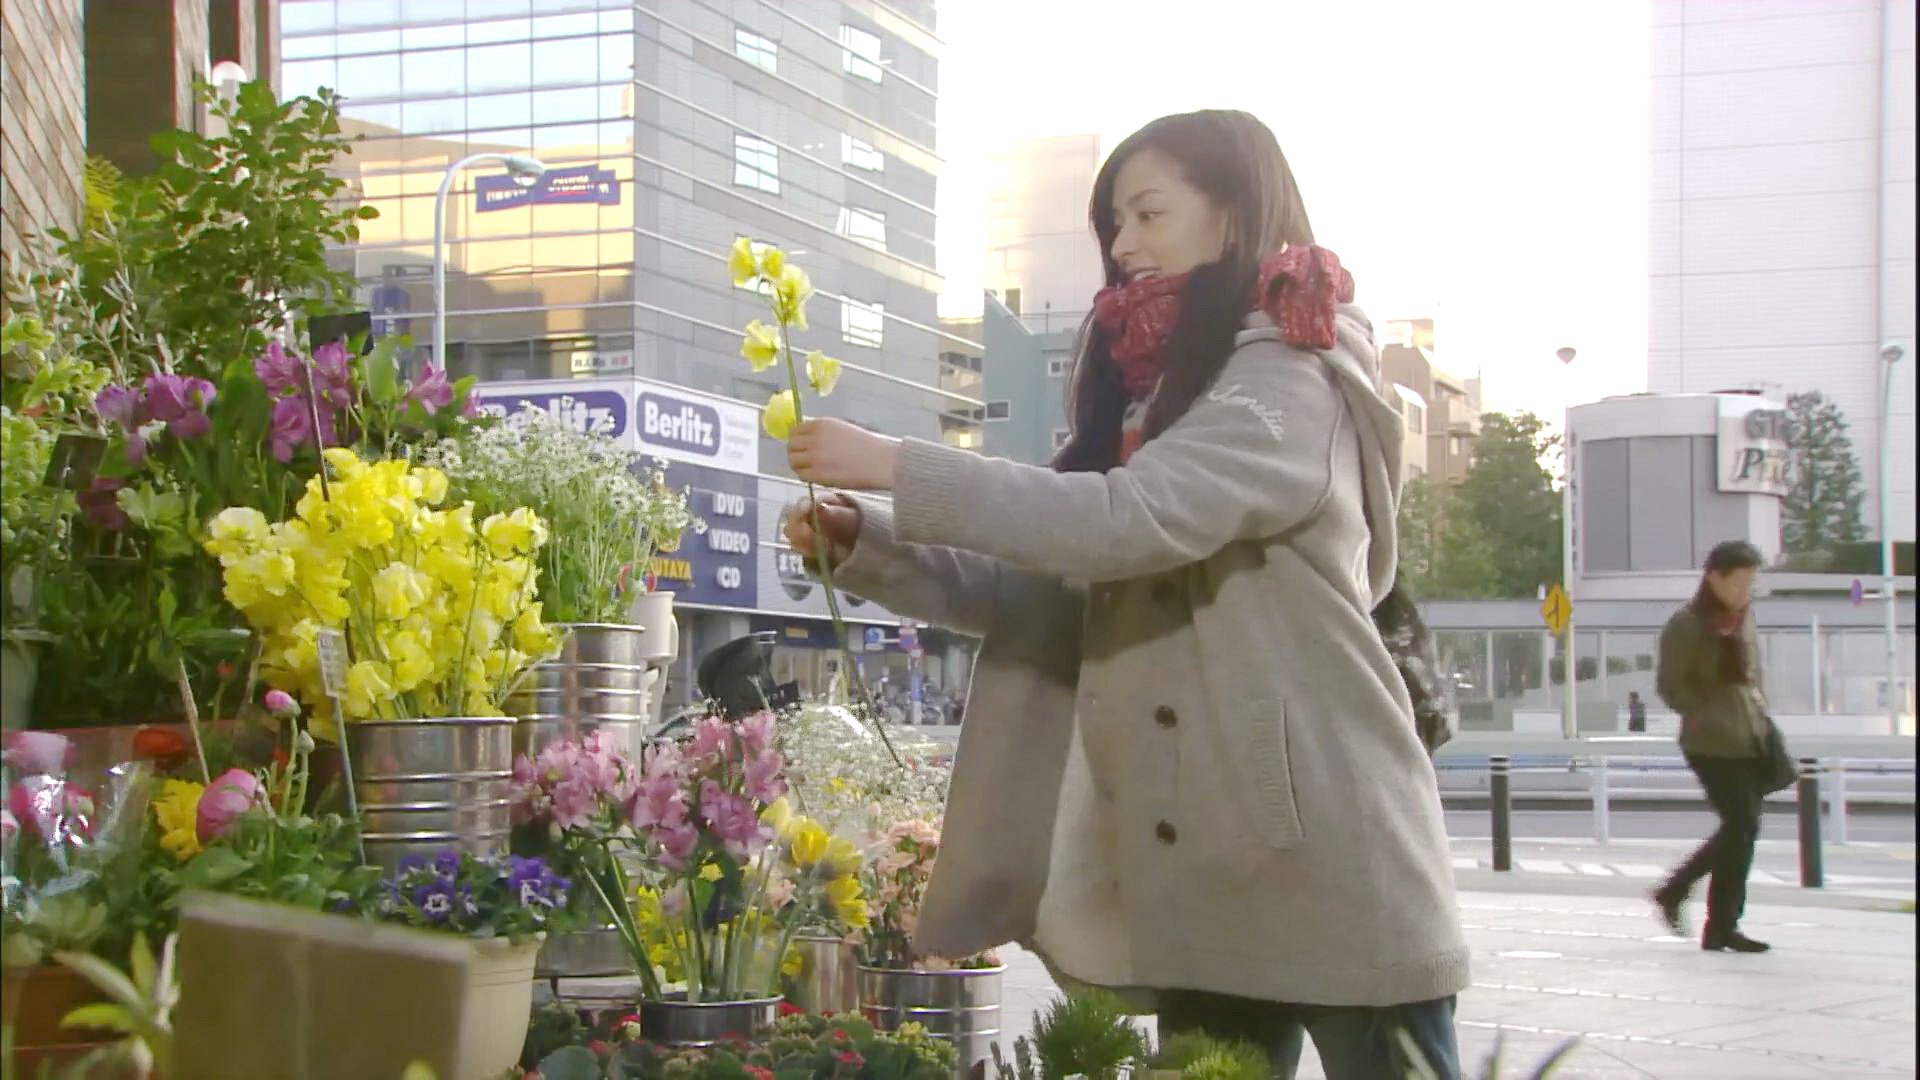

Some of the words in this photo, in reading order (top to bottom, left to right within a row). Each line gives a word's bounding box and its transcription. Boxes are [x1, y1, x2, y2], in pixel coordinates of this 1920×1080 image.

[481, 397, 614, 436] elitz
[644, 400, 713, 447] Berlitz
[713, 492, 745, 517] DVD
[709, 528, 750, 555] VIDEO
[642, 557, 692, 581] UTAYA
[717, 566, 741, 589] CD
